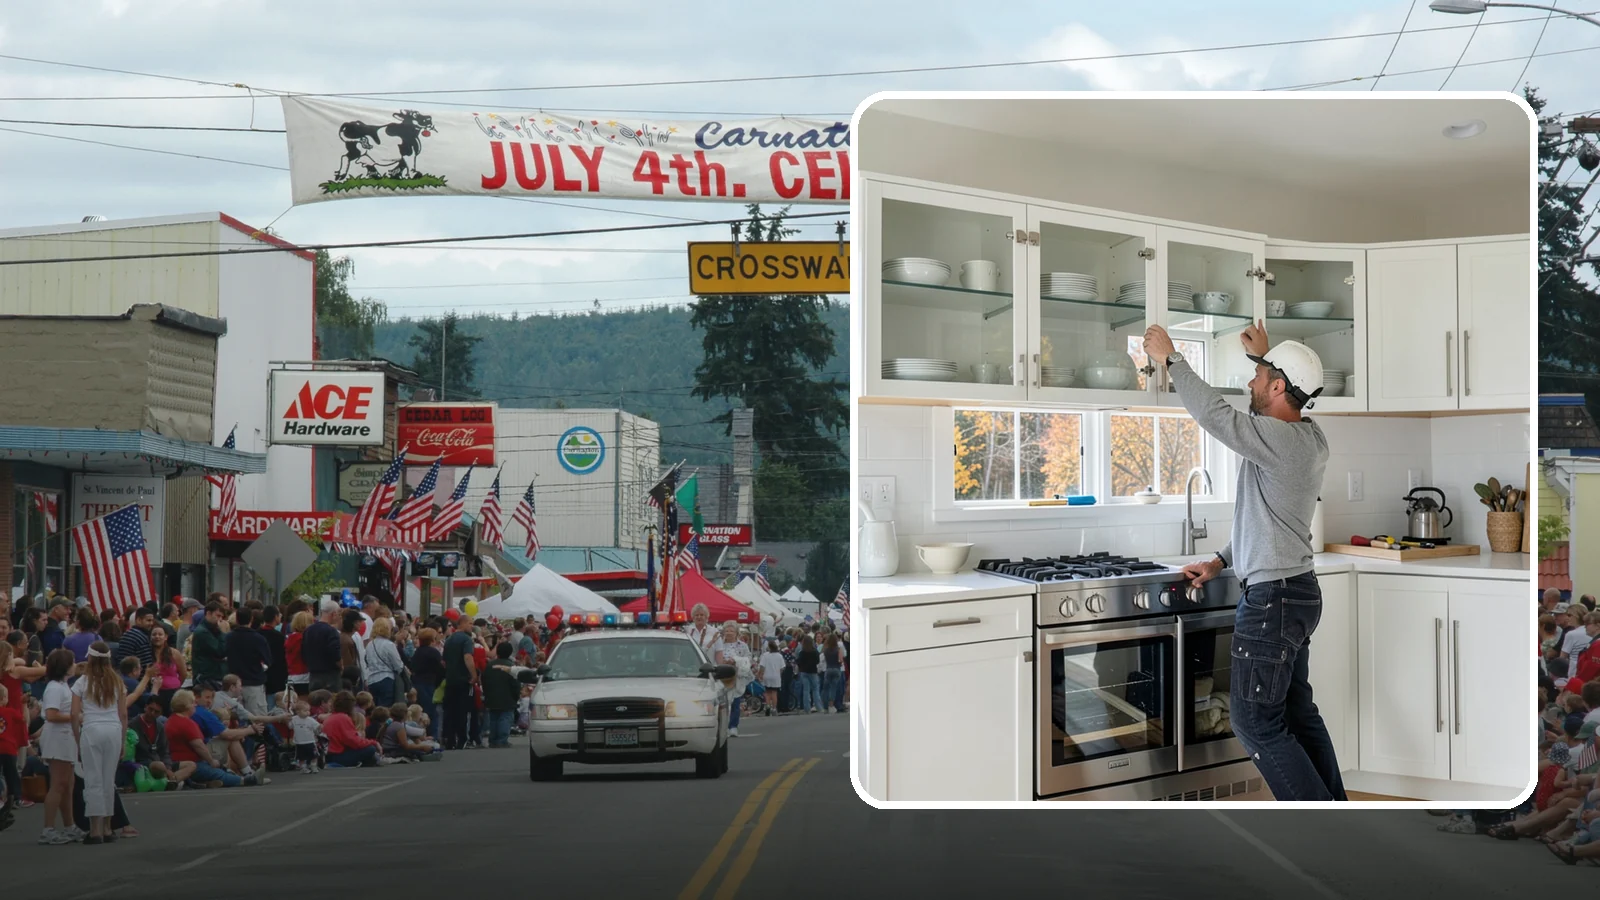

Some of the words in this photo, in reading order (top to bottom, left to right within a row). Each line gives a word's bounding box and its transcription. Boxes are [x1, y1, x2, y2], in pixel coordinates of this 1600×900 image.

[481, 140, 604, 192] JULY
[632, 150, 748, 198] 4th.
[696, 254, 850, 280] CROSSWA
[283, 379, 374, 420] ACE
[406, 409, 452, 422] CEDAR
[283, 420, 371, 437] Hardware
[96, 485, 124, 495] Vincent
[126, 486, 136, 495] de
[137, 486, 155, 495] Paul
[212, 515, 331, 535] HARDARE
[688, 526, 742, 535] CRNATION
[699, 535, 730, 543] GLASS
